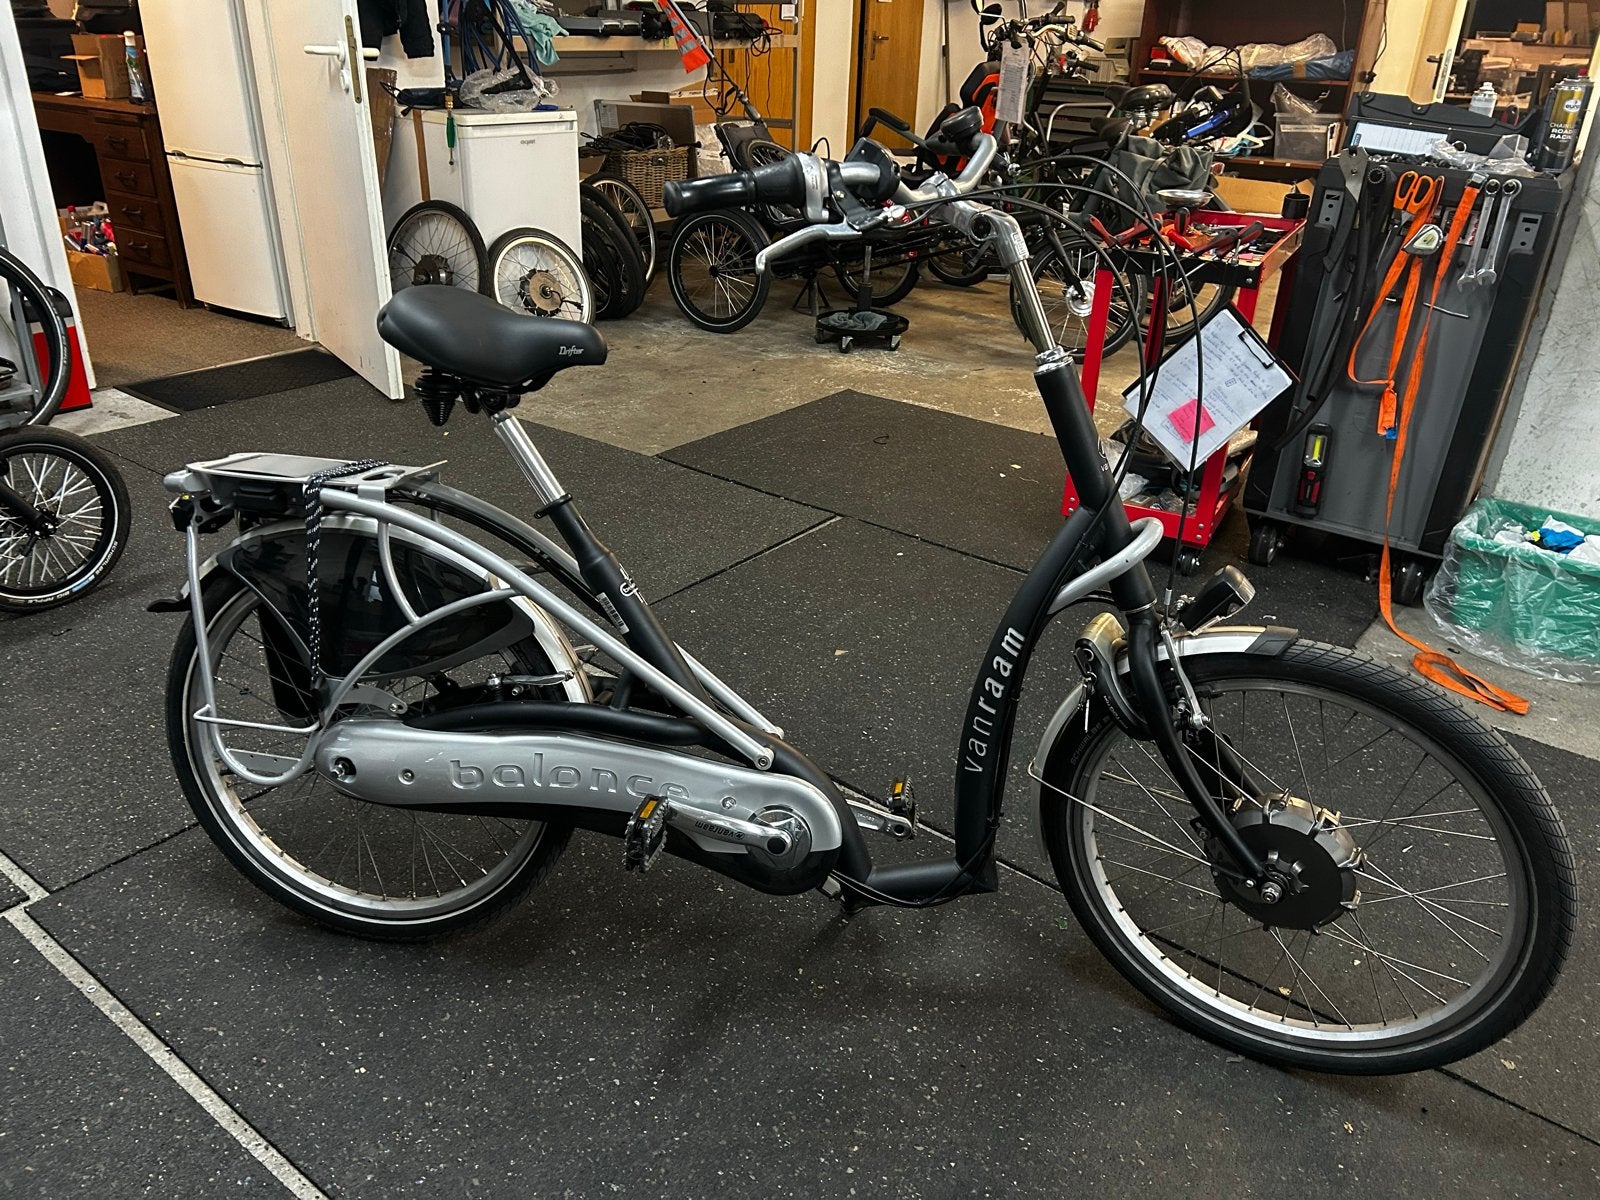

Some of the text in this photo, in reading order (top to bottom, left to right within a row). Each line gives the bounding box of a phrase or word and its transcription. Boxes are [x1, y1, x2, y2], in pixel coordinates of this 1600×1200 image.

[558, 345, 585, 357] Drifter
[964, 626, 1026, 773] vanraam
[449, 752, 691, 800] balance
[694, 820, 735, 838] vanraam
